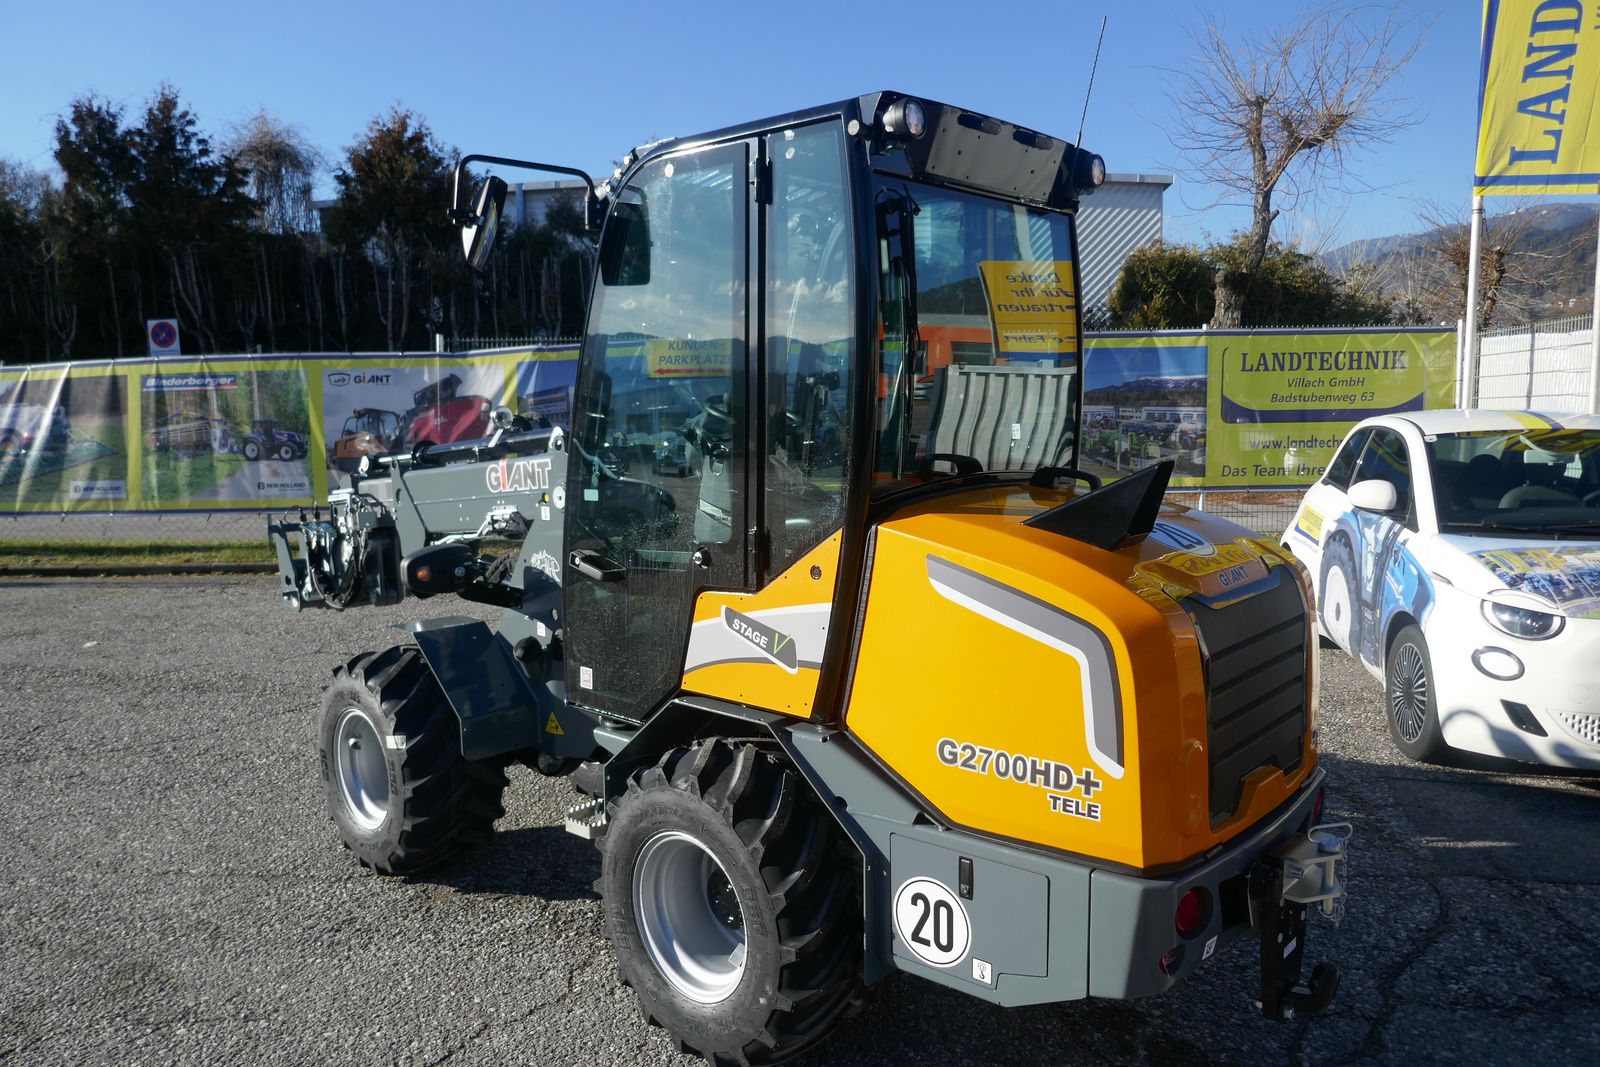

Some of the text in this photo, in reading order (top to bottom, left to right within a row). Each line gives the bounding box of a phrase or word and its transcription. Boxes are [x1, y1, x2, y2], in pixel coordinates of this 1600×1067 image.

[1240, 350, 1407, 373] LANDTECHNIK
[145, 377, 235, 386] Binderberger
[1287, 377, 1365, 388] Villach GmbH
[1270, 392, 1375, 404] Badstubenweg 63
[1221, 465, 1247, 477] Das
[732, 618, 792, 655] STAGE V
[937, 737, 1102, 798] G2700HD+
[1047, 793, 1101, 822] TELE
[910, 892, 954, 953] 20
